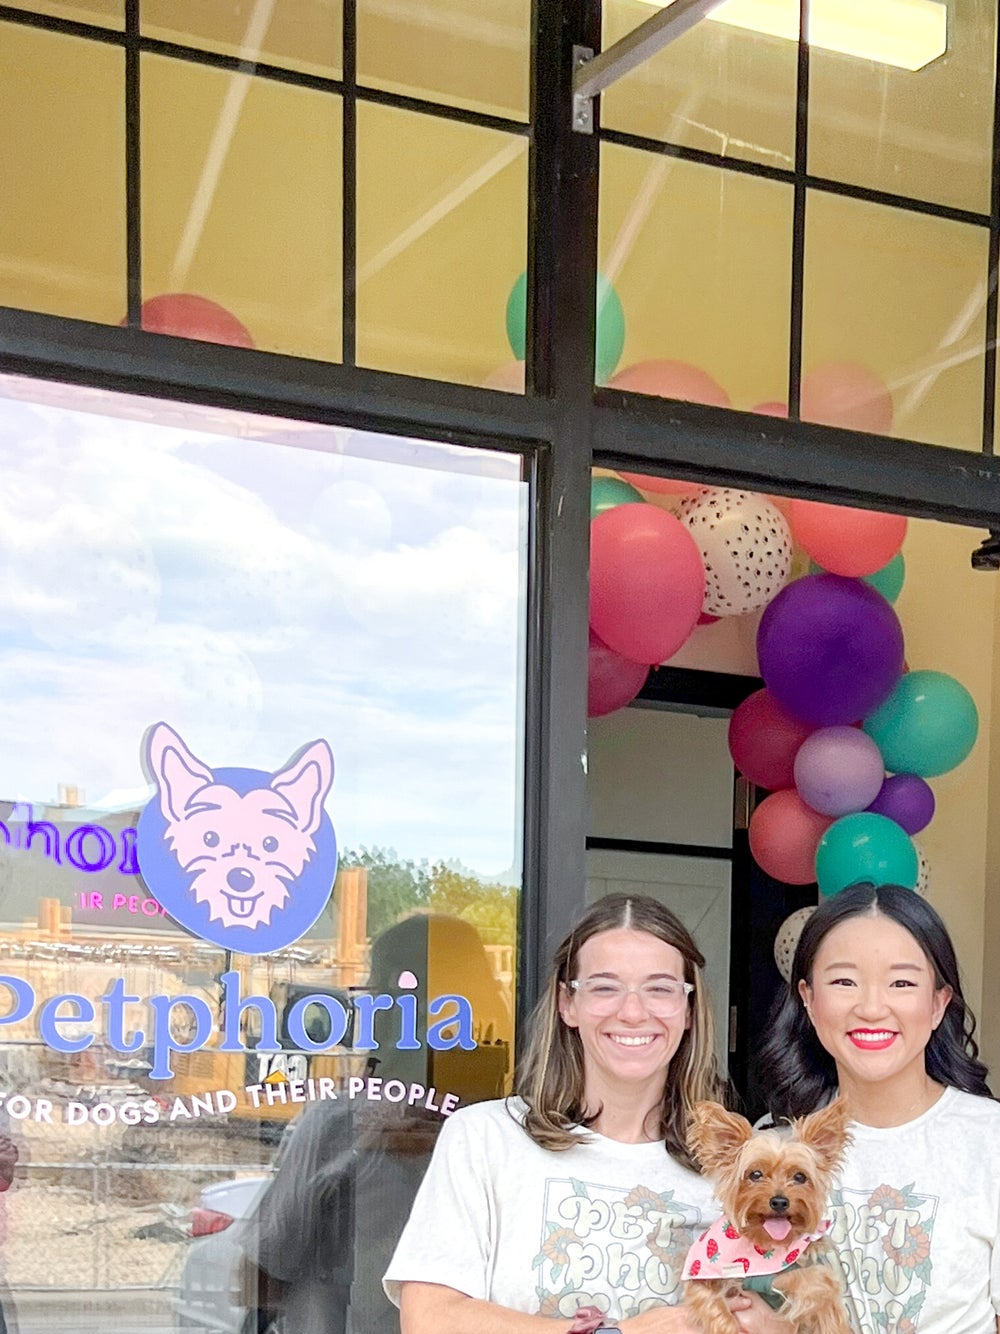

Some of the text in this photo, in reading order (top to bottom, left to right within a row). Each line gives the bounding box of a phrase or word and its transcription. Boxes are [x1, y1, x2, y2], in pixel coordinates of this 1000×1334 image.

[112, 893, 167, 917] PEO
[0, 1077, 460, 1126] OR DOGS AND THEIR PEOPLE
[558, 1196, 686, 1248] PET
